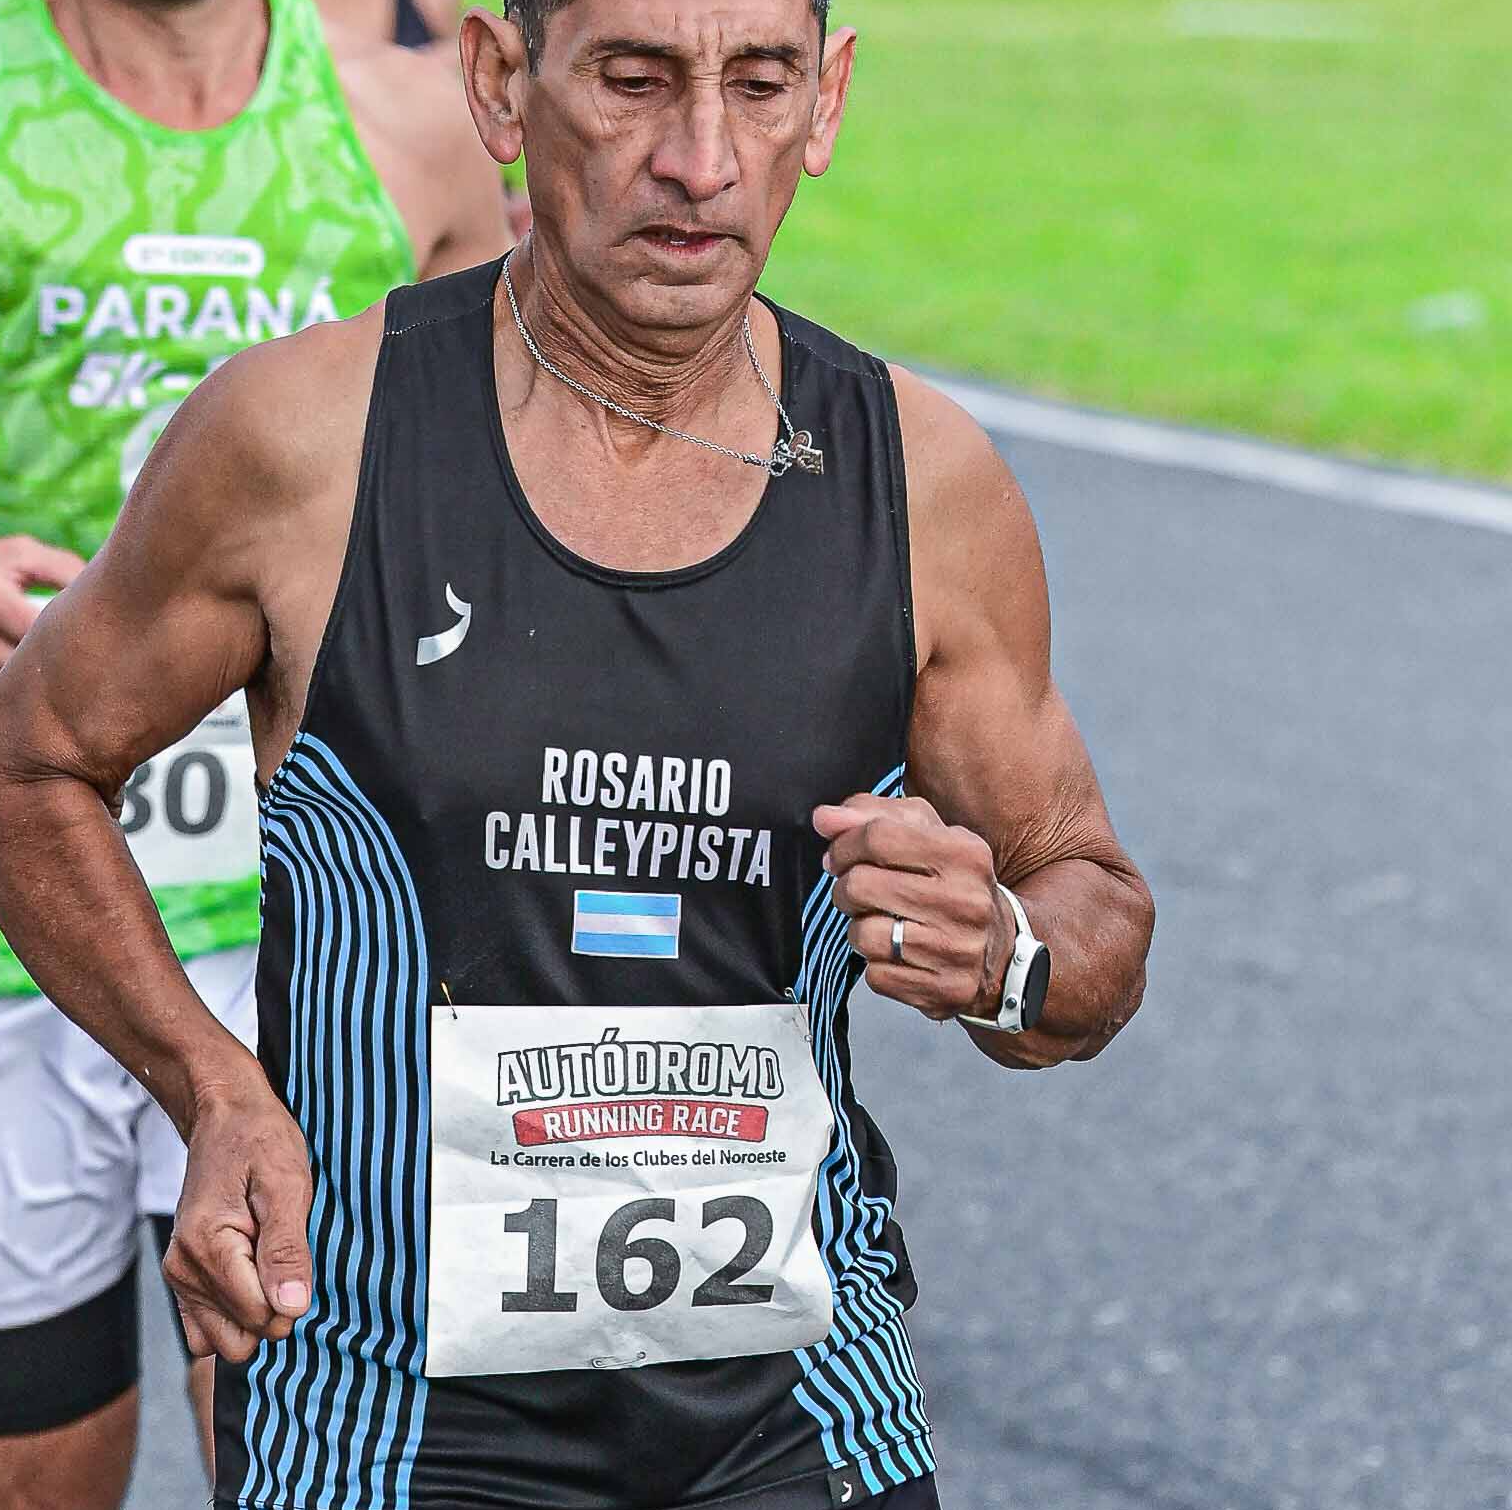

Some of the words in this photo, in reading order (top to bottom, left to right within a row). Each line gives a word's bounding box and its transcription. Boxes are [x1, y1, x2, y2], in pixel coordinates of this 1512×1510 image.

[39, 277, 337, 340] PARANÁ
[541, 746, 731, 816] ROSARIO
[484, 811, 772, 887] CALLEYPISTA
[496, 1028, 784, 1106] AUTÓDROMO
[543, 1103, 664, 1140] RUNNING
[672, 1106, 742, 1137] RACE
[490, 1150, 509, 1166] La
[513, 1151, 575, 1168] Carrera
[579, 1151, 601, 1167] de
[605, 1151, 629, 1168] los
[633, 1149, 688, 1166] Clubes
[691, 1149, 716, 1166] del
[719, 1149, 787, 1165] Noroeste
[500, 1195, 776, 1313] 162
